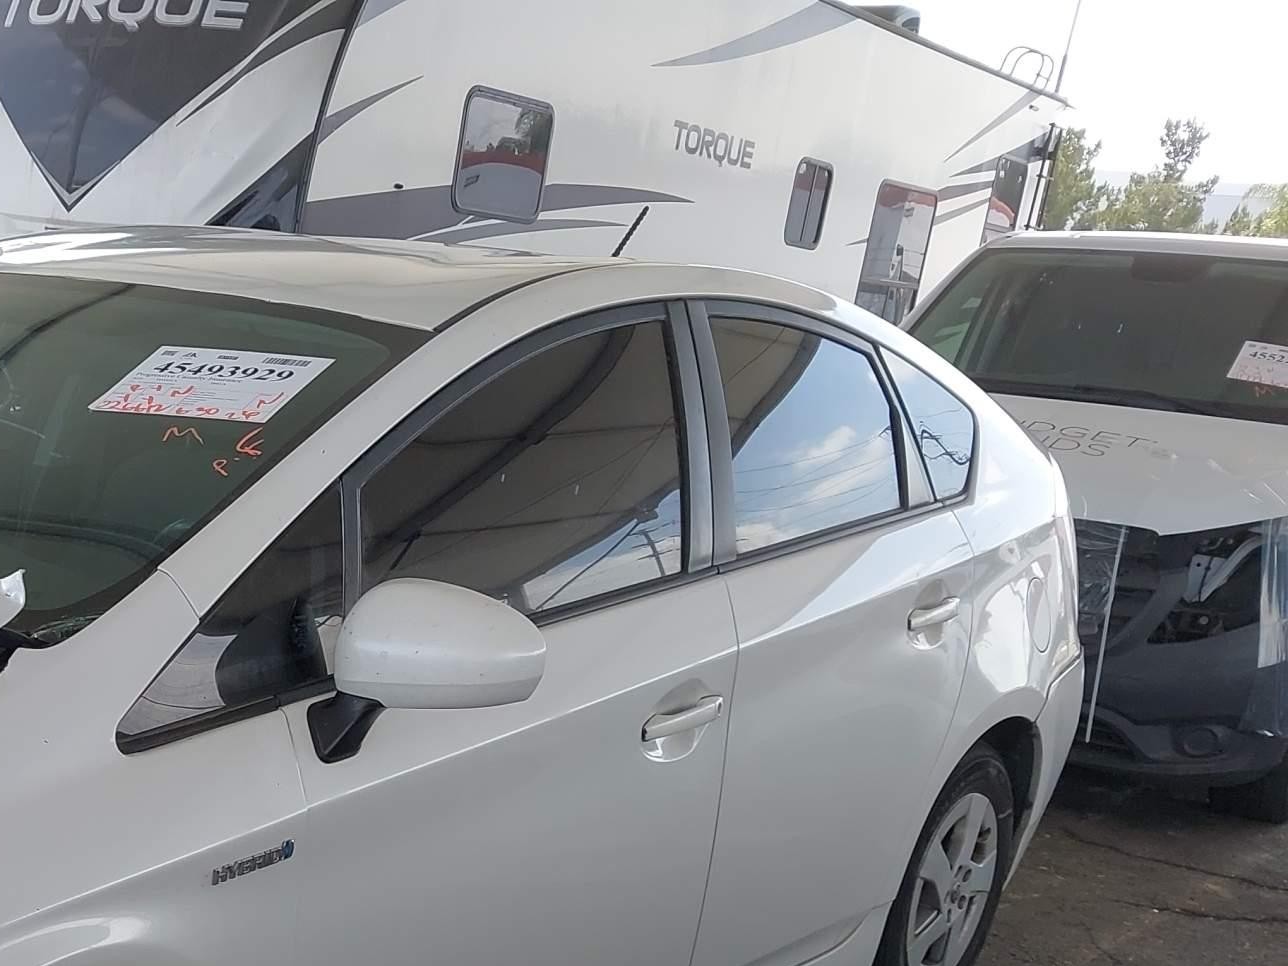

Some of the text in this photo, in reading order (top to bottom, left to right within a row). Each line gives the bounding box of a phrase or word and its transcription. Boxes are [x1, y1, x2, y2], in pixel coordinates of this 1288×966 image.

[673, 119, 756, 170] TORQUE
[153, 361, 295, 381] 45493929
[212, 847, 283, 886] HYBRID
